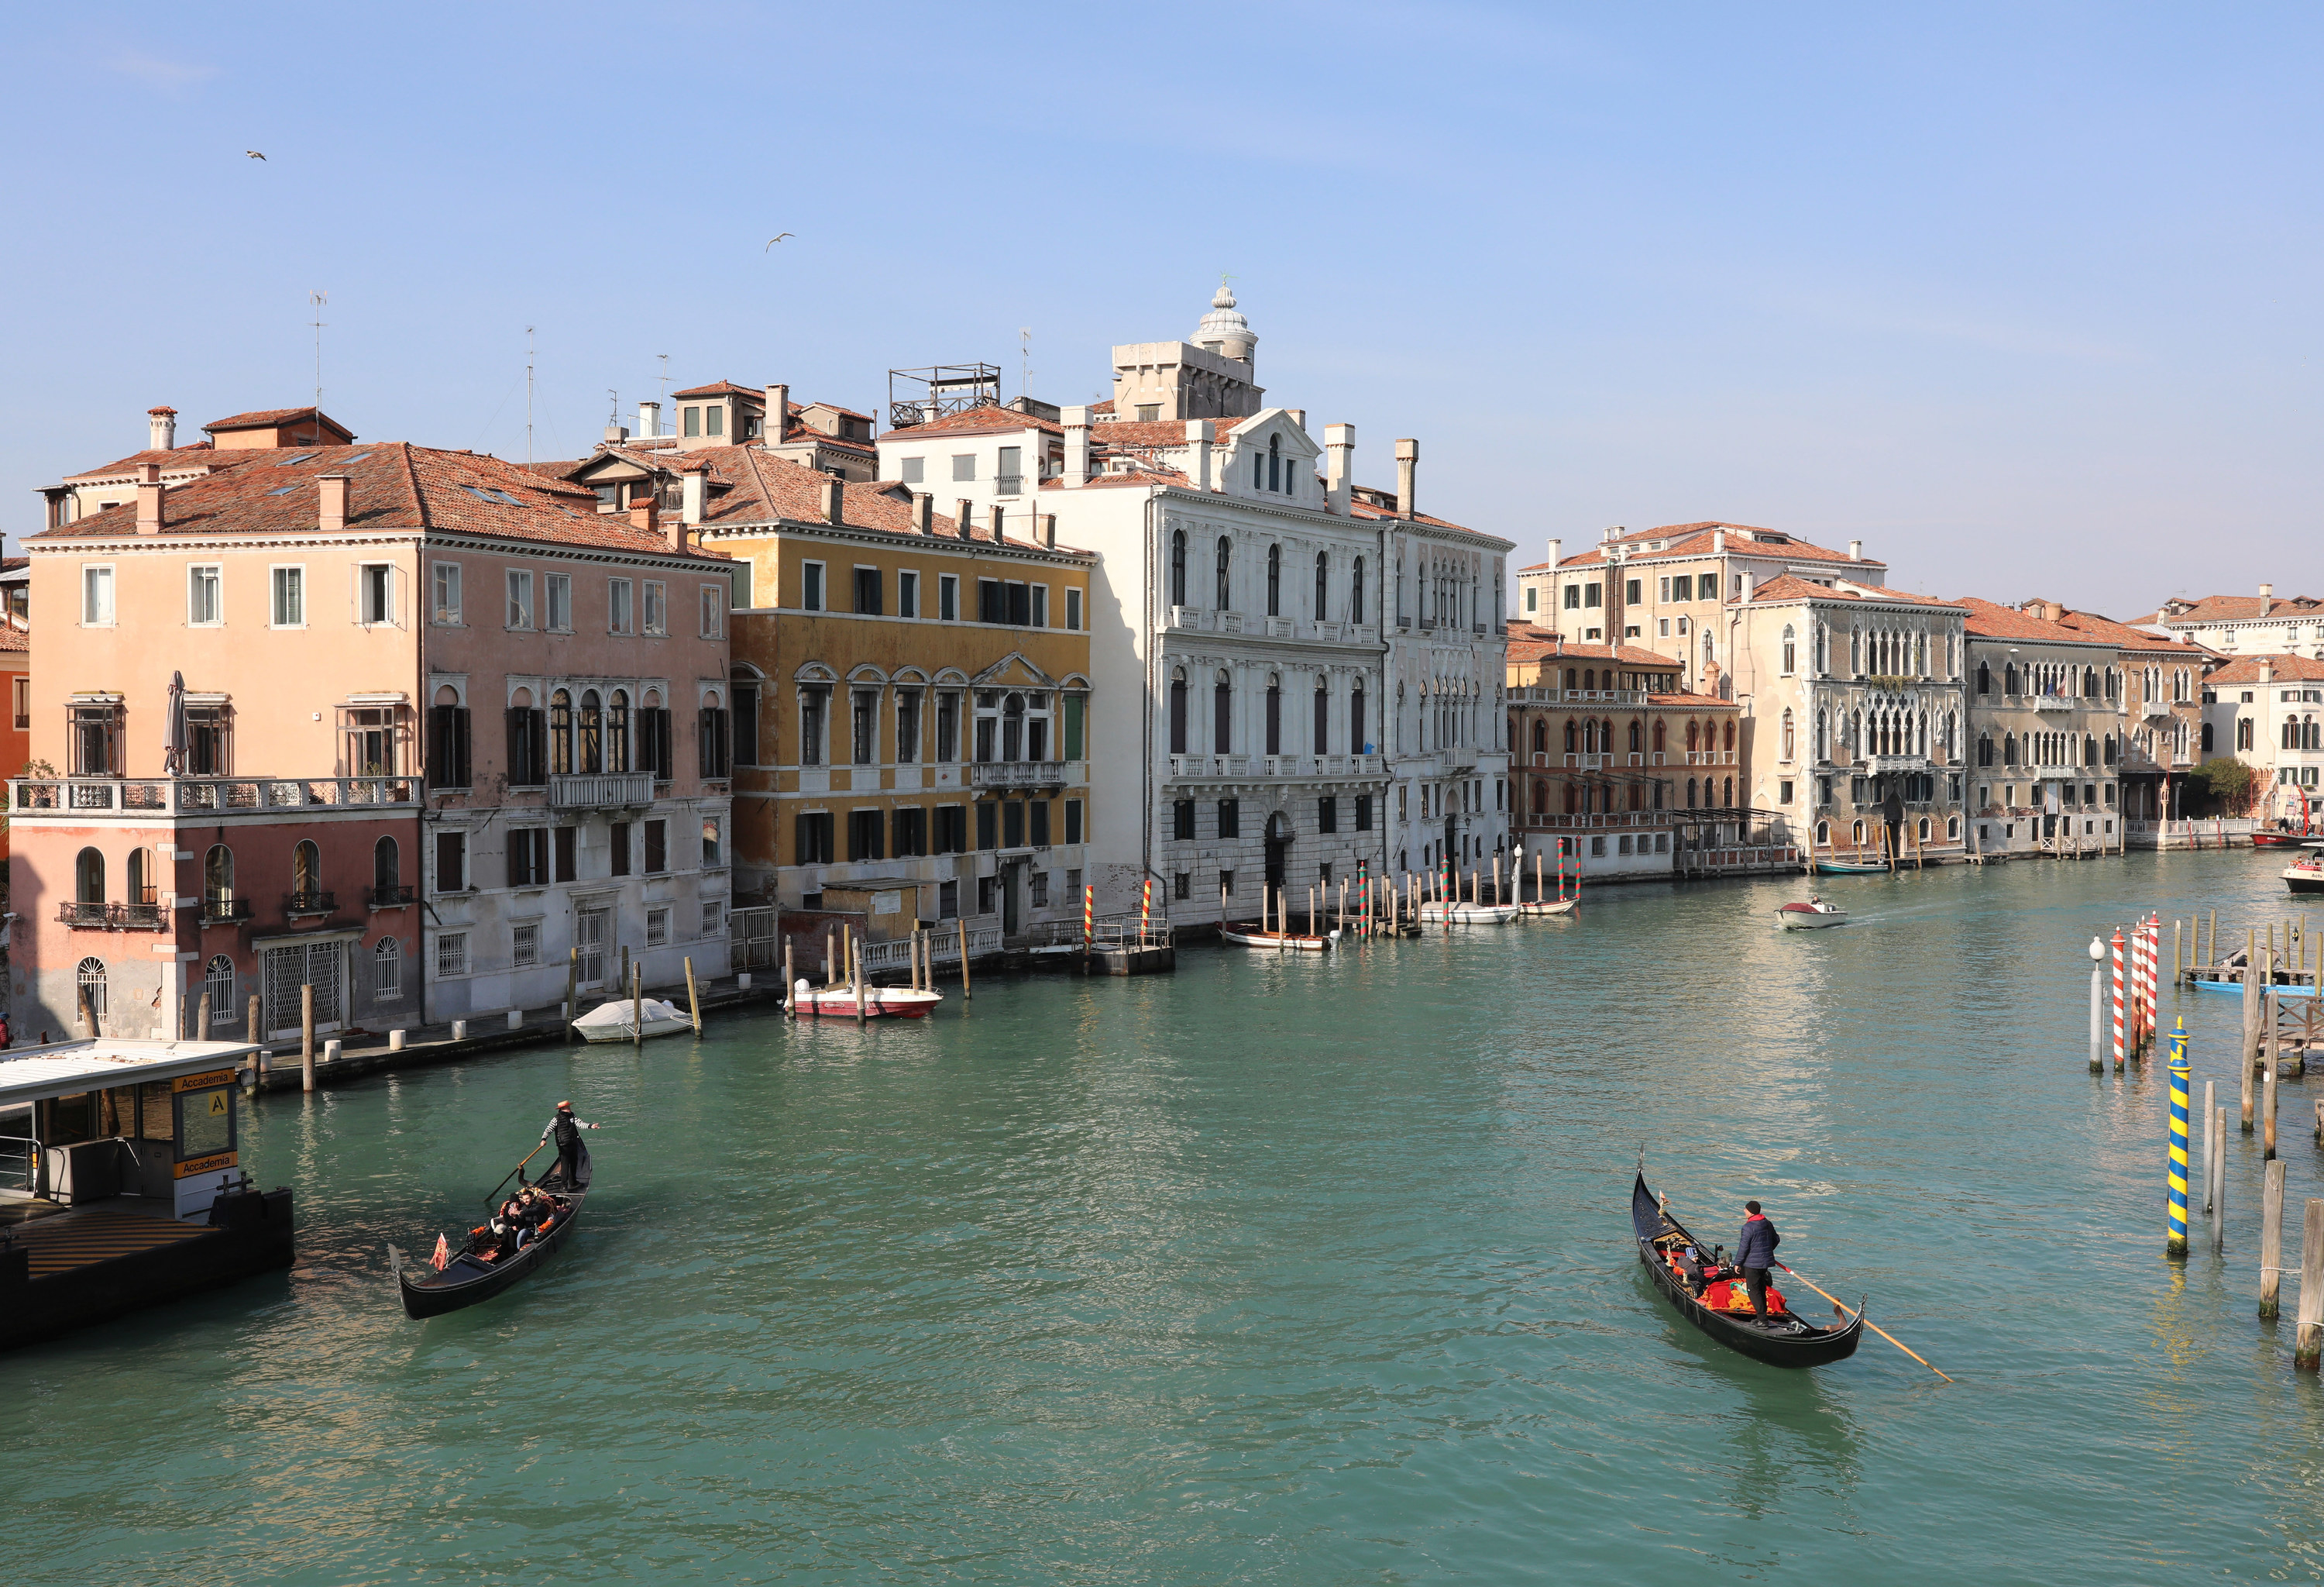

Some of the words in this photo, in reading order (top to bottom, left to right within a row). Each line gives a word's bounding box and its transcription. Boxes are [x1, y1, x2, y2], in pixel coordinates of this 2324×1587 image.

[181, 1072, 229, 1089] Accademia
[212, 1096, 224, 1112] A
[183, 1155, 230, 1173] Accademia
